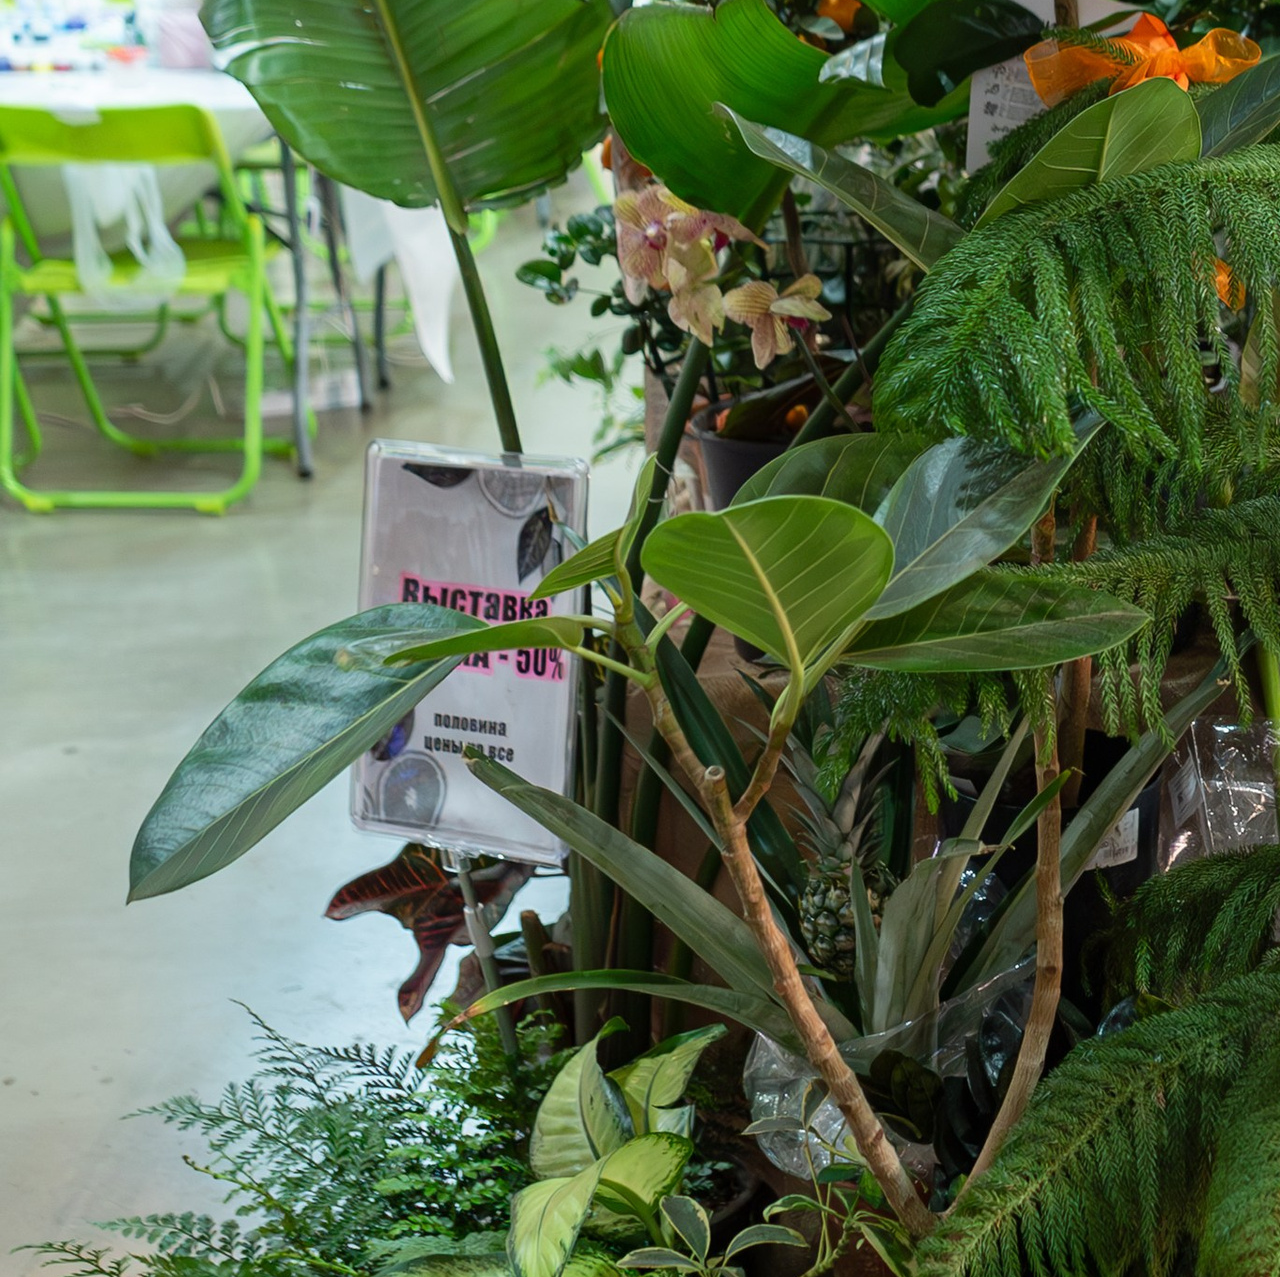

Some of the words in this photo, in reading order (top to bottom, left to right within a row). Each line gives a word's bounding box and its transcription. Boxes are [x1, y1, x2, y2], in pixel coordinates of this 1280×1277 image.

[516, 647, 564, 680] 50%
[434, 712, 507, 737] половина
[424, 735, 463, 754] цены
[488, 744, 514, 762] все
